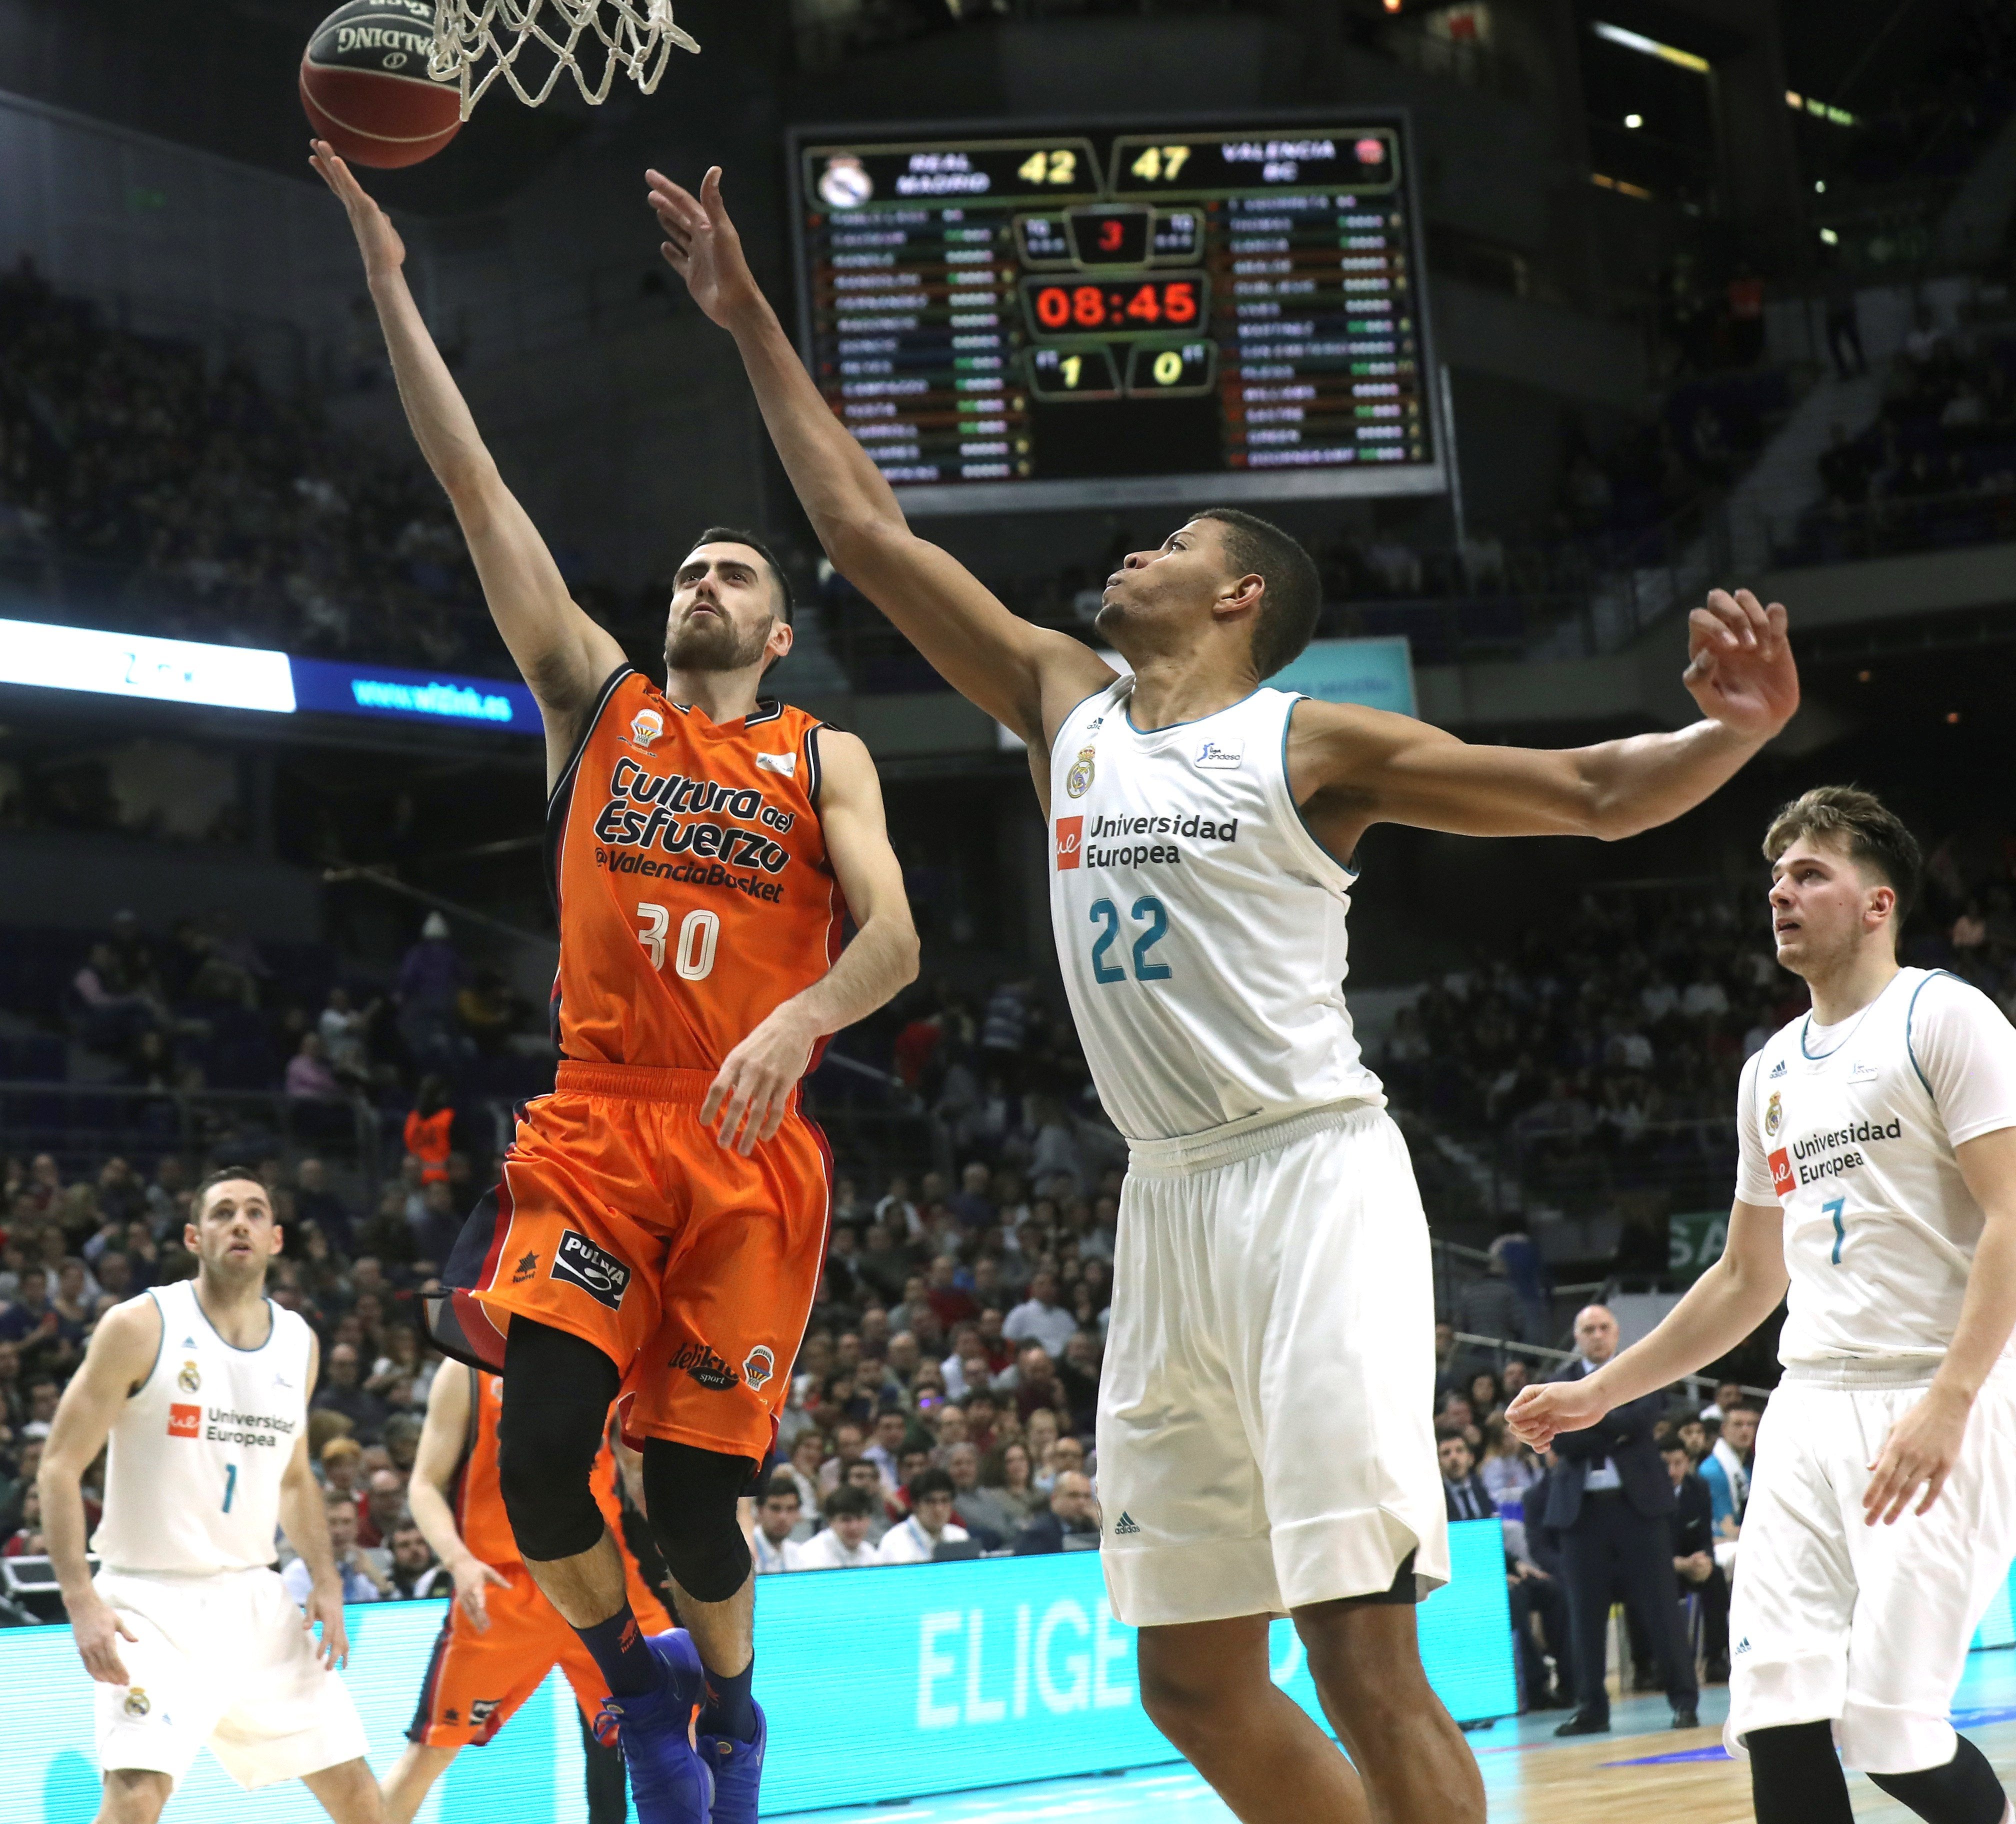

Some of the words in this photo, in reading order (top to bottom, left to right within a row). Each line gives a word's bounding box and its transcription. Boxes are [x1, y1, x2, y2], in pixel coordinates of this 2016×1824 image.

[908, 152, 971, 173] REAL
[1018, 150, 1076, 184] 42
[1131, 145, 1191, 180] 47
[896, 172, 990, 195] MADRID
[1098, 220, 1124, 250] 3
[1036, 282, 1196, 328] 08:45
[1060, 356, 1082, 388] 1
[1154, 351, 1182, 386] 0
[610, 756, 762, 820] Cultura
[760, 806, 795, 834] del
[594, 800, 790, 874] Esfuerzo
[1090, 814, 1238, 842] Universidad
[1087, 844, 1180, 869] Europea
[595, 848, 784, 903] @ValenciaBasket
[637, 902, 720, 980] 30
[1090, 896, 1172, 984] 22
[1793, 1118, 1902, 1160] Universidad
[1800, 1150, 1864, 1186] Europea
[1822, 1197, 1845, 1265] 7
[700, 1374, 724, 1384] sport
[206, 1426, 276, 1446] Europea
[208, 1407, 295, 1434] Universidad
[222, 1464, 237, 1514] 1
[1115, 1524, 1140, 1534] adidas
[916, 1598, 1134, 1728] ELIGE
